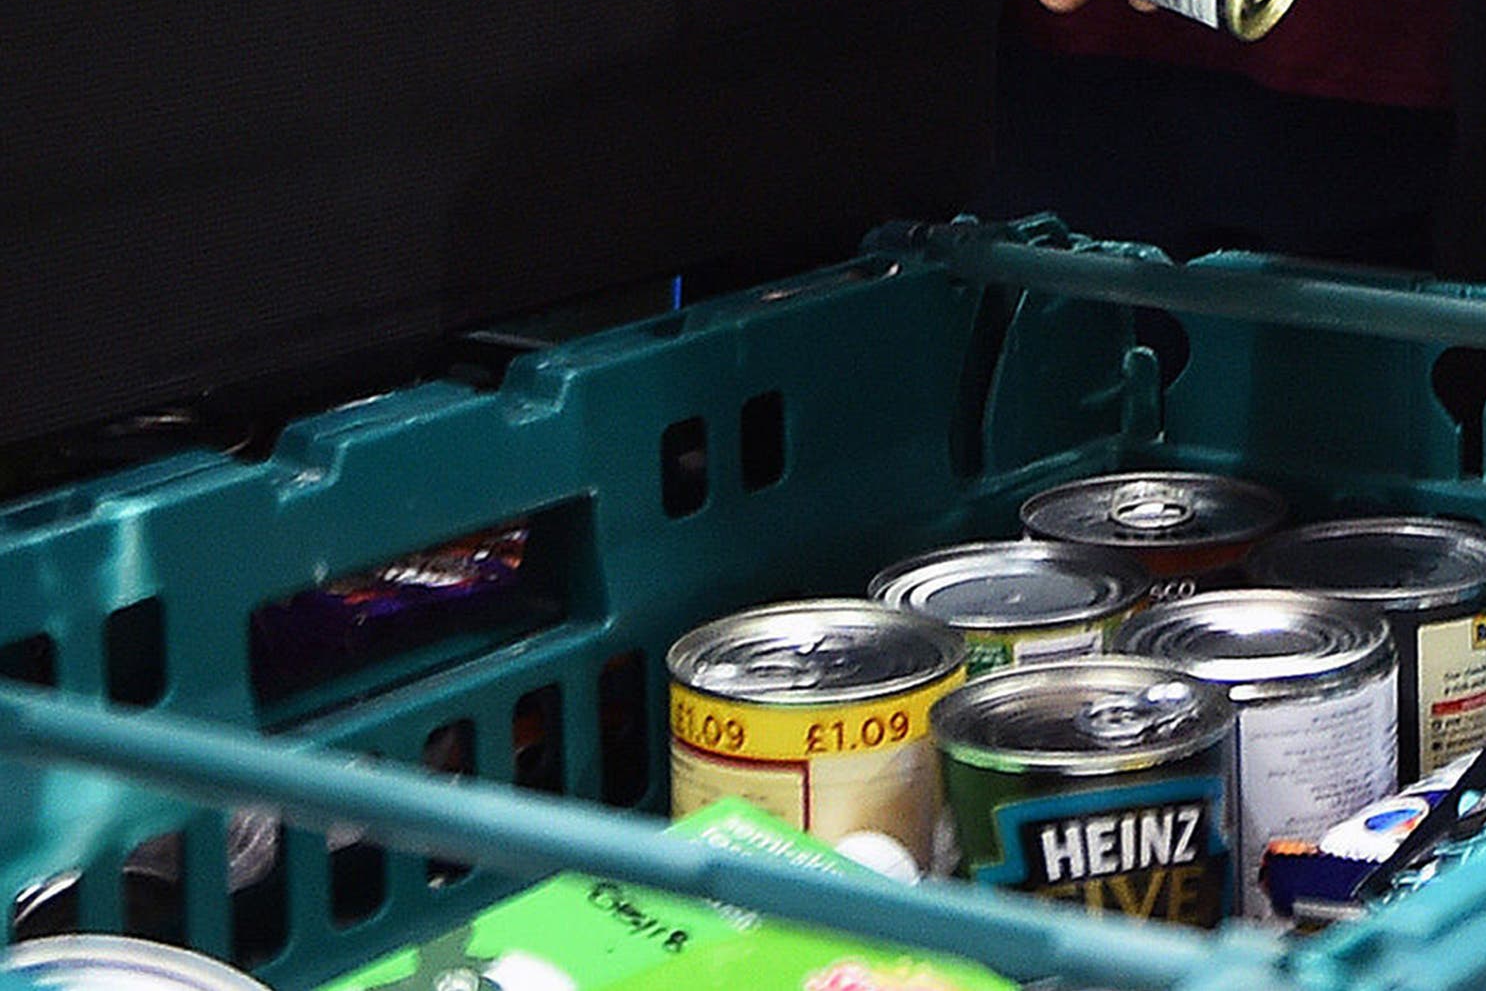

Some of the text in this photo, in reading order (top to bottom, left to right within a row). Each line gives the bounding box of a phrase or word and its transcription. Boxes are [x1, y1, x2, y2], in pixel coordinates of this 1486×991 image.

[675, 702, 745, 751] £1.09
[804, 711, 910, 754] £1.09
[1041, 807, 1201, 883] HEINZ
